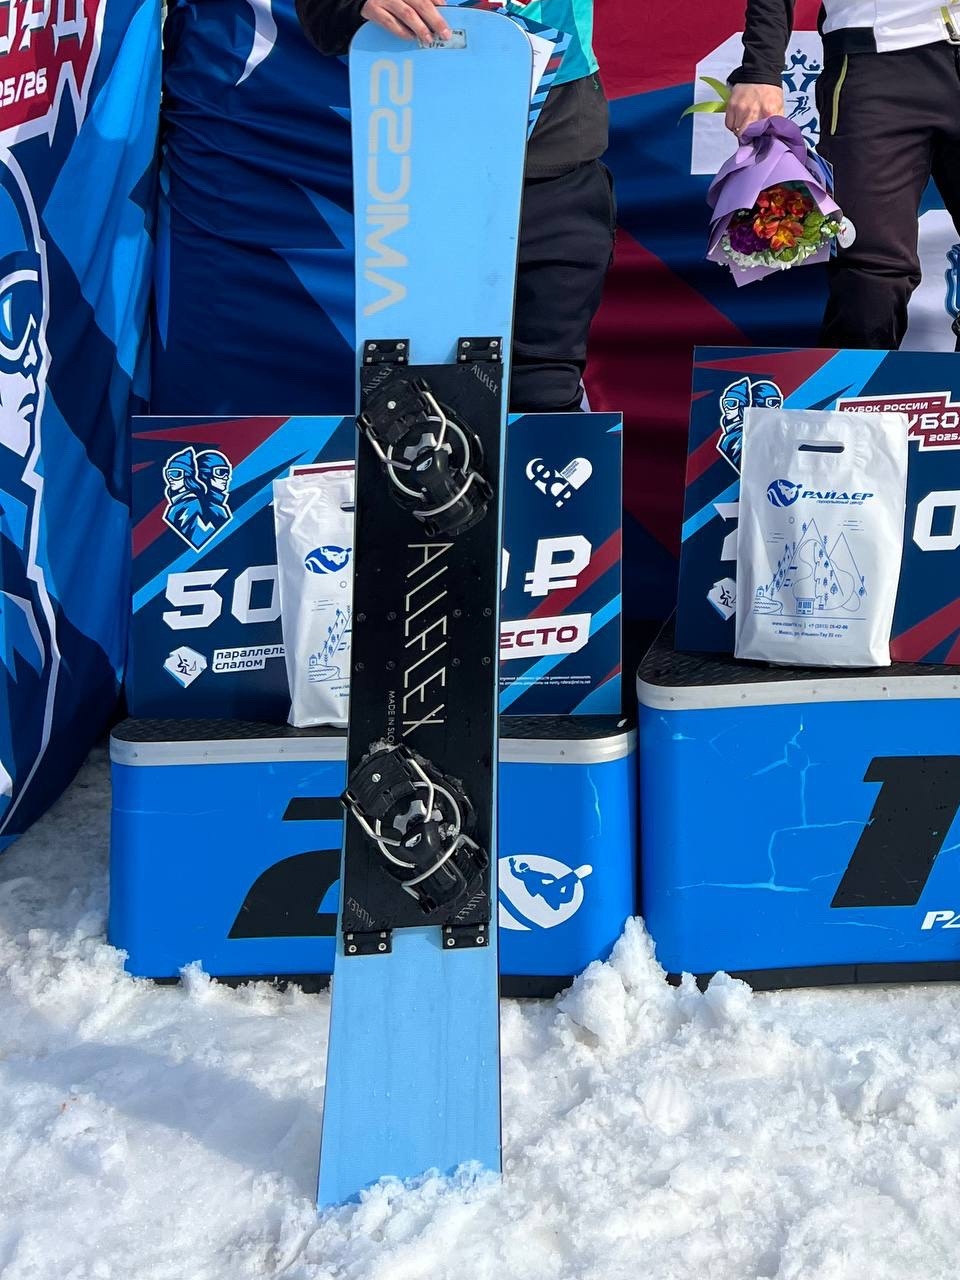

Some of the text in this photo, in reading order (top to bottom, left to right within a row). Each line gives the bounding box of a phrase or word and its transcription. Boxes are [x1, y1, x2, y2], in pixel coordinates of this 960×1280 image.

[0, 67, 48, 109] 5/26
[471, 364, 499, 394] ALLFLEX
[883, 401, 929, 412] РОССИИ
[402, 542, 455, 737] ALLFLEX
[499, 625, 579, 649] ЕСТО
[215, 659, 263, 670] слалом
[216, 646, 286, 660] параллель
[388, 690, 396, 716] MADE
[387, 727, 396, 744] SLO
